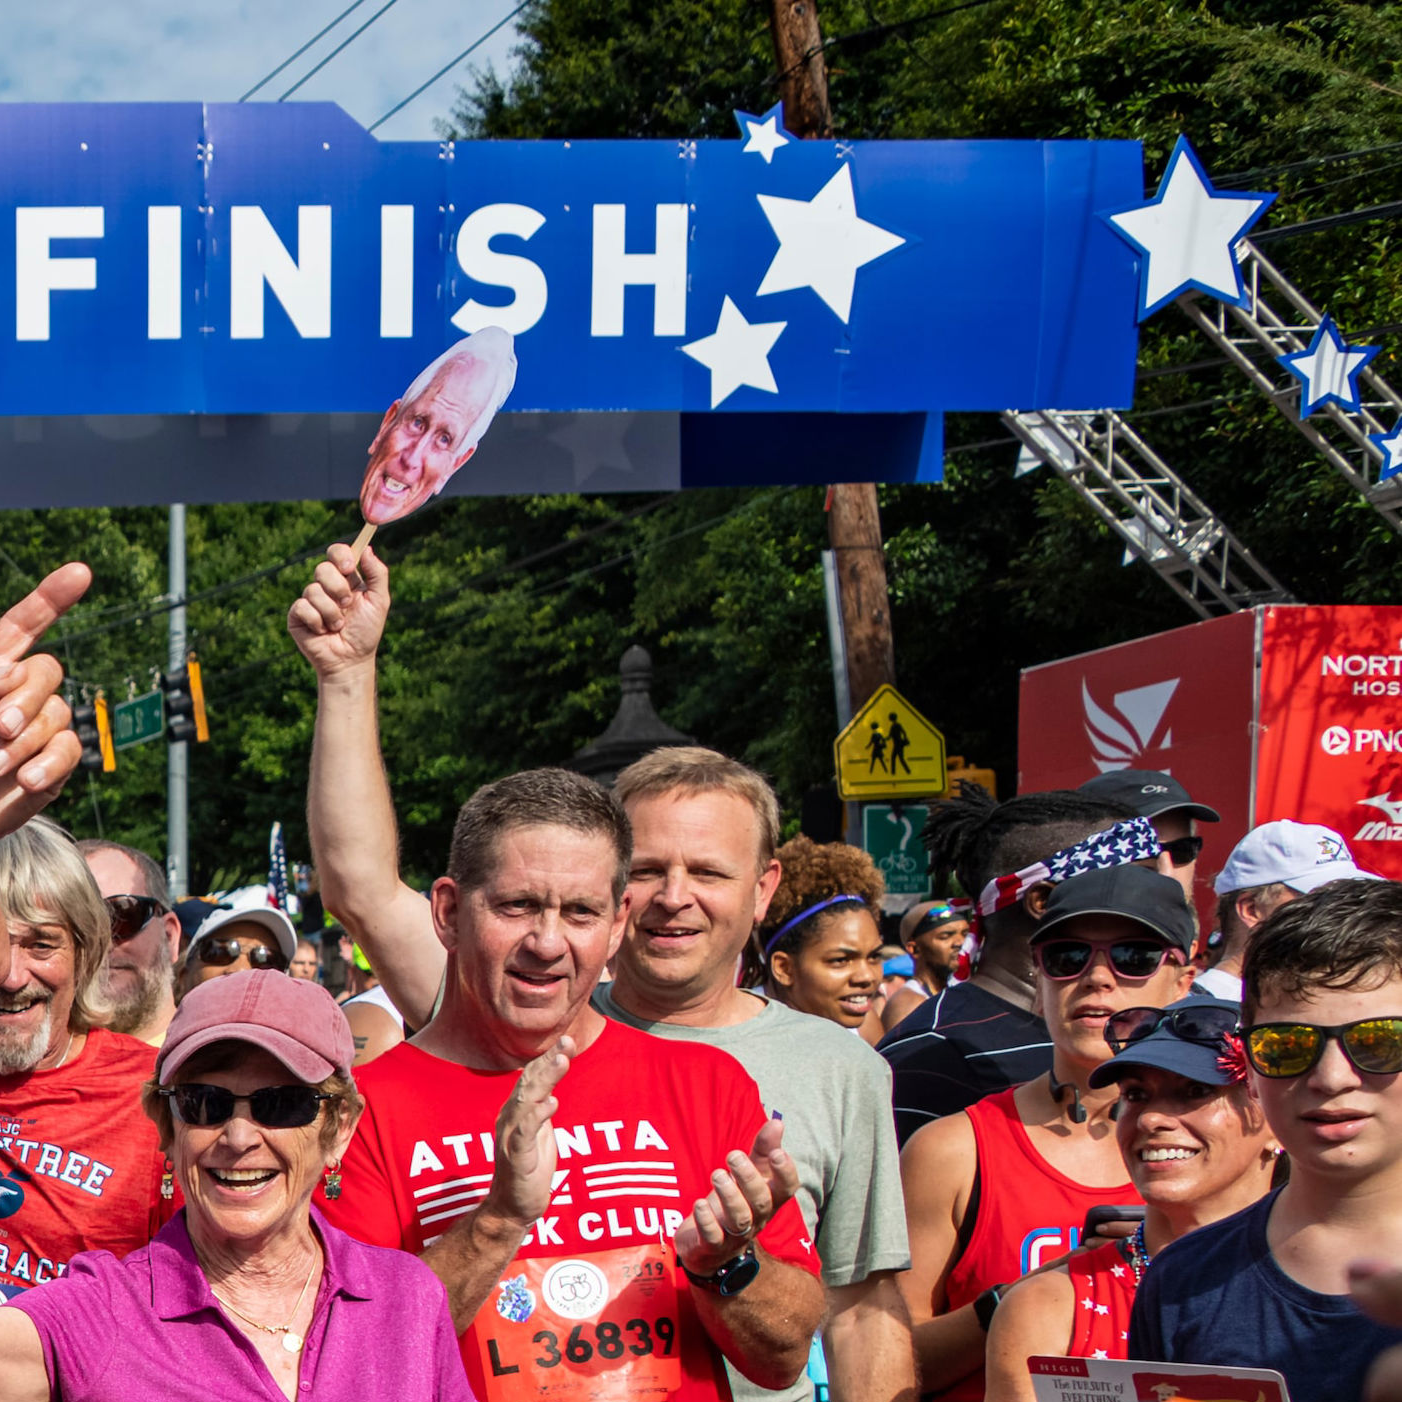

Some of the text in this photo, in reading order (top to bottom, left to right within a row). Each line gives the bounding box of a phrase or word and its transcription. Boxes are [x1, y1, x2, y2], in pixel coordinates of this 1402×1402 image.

[16, 203, 689, 342] FINISH
[578, 1207, 684, 1242] CLUB
[487, 1317, 675, 1377] L 36839
